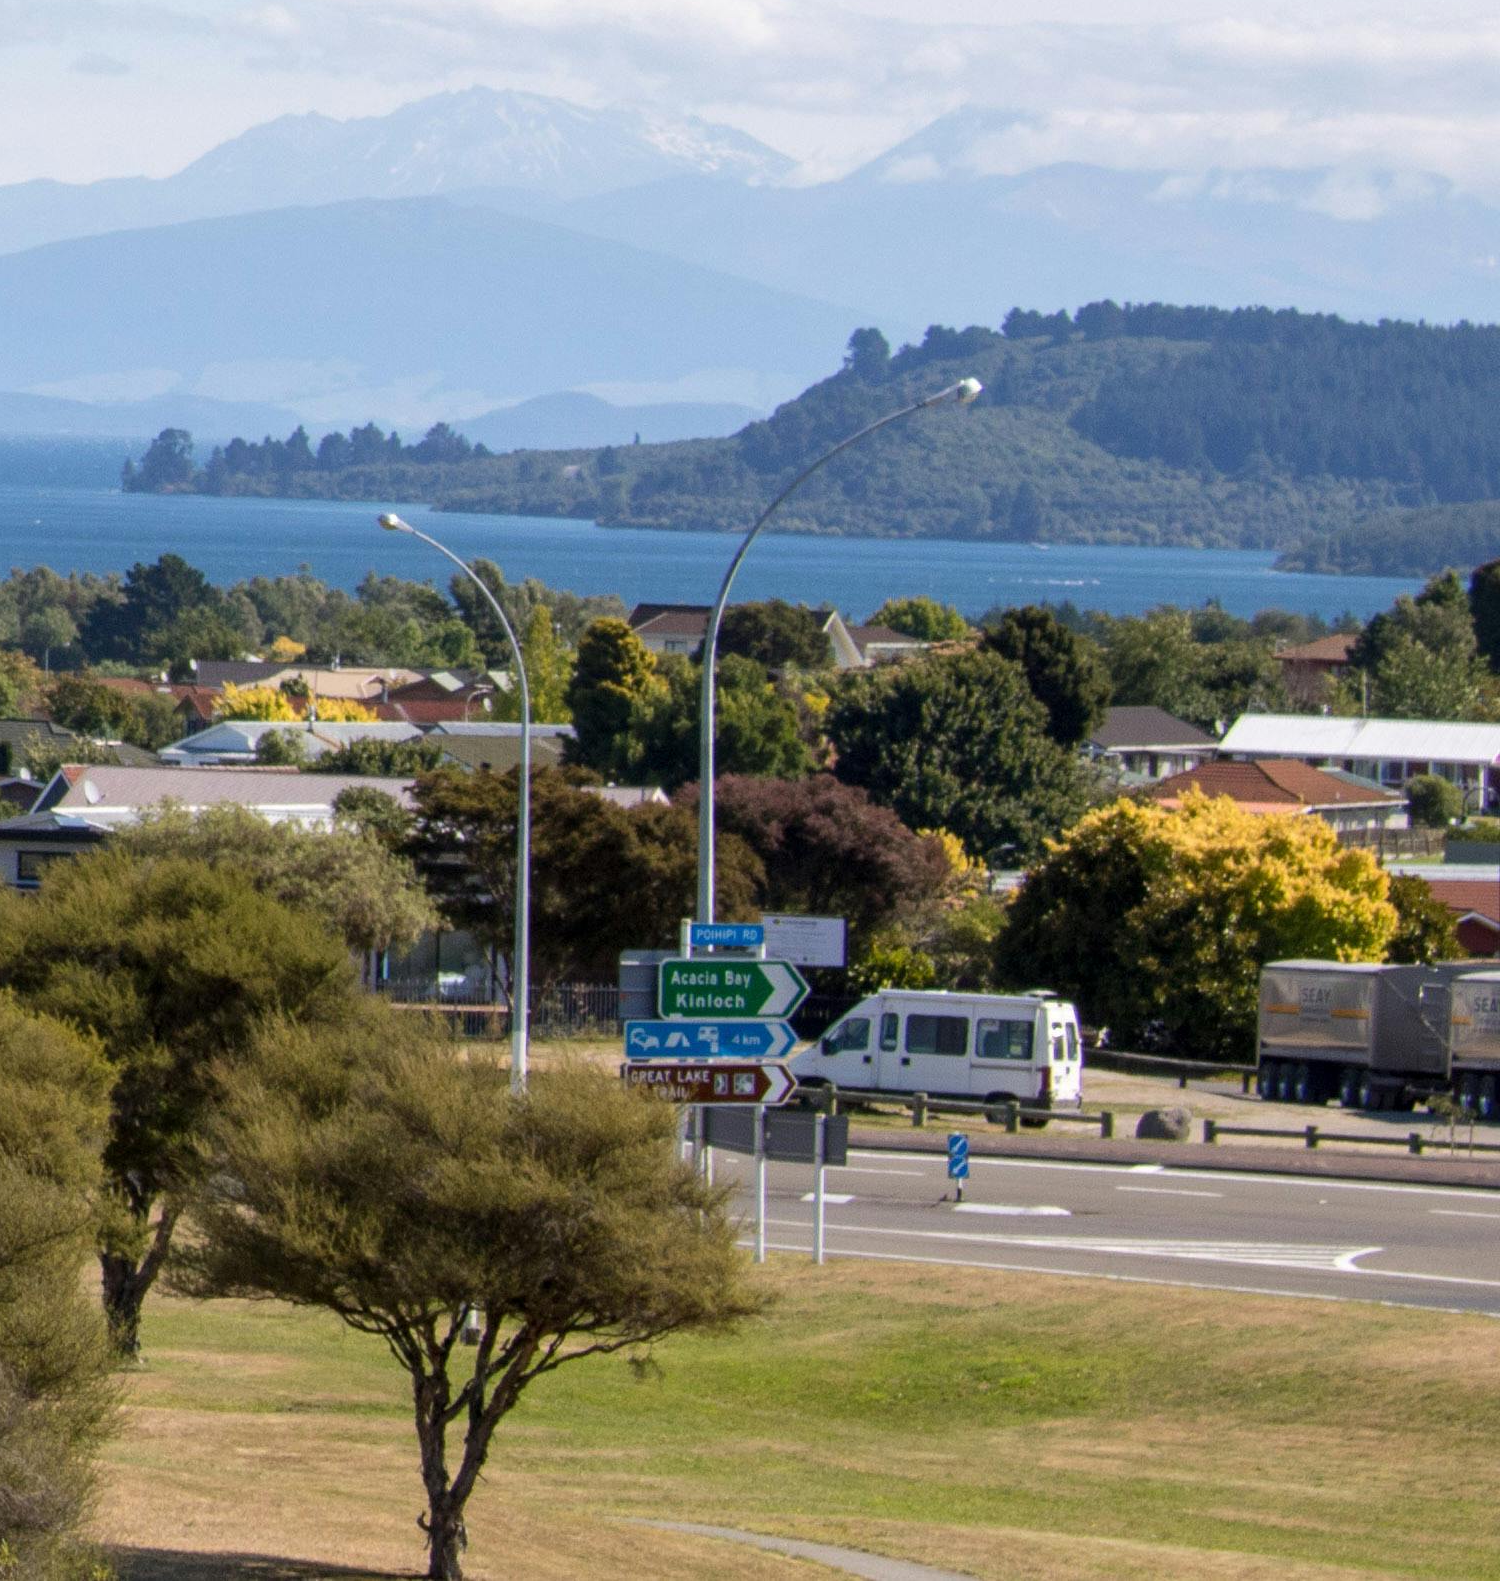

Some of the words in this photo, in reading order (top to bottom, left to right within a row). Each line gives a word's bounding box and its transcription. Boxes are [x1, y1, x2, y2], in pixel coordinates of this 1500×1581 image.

[696, 928, 737, 941] POIHIPI
[743, 929, 758, 941] RD
[671, 970, 718, 985] Acacia
[725, 970, 752, 989] Bay
[676, 992, 745, 1008] Kinloch
[1301, 986, 1332, 1004] SEAY
[1473, 995, 1500, 1013] SEA
[731, 1035, 740, 1045] 4
[742, 1034, 761, 1045] km
[631, 1070, 671, 1083] GREAT
[677, 1070, 710, 1083] LAKE
